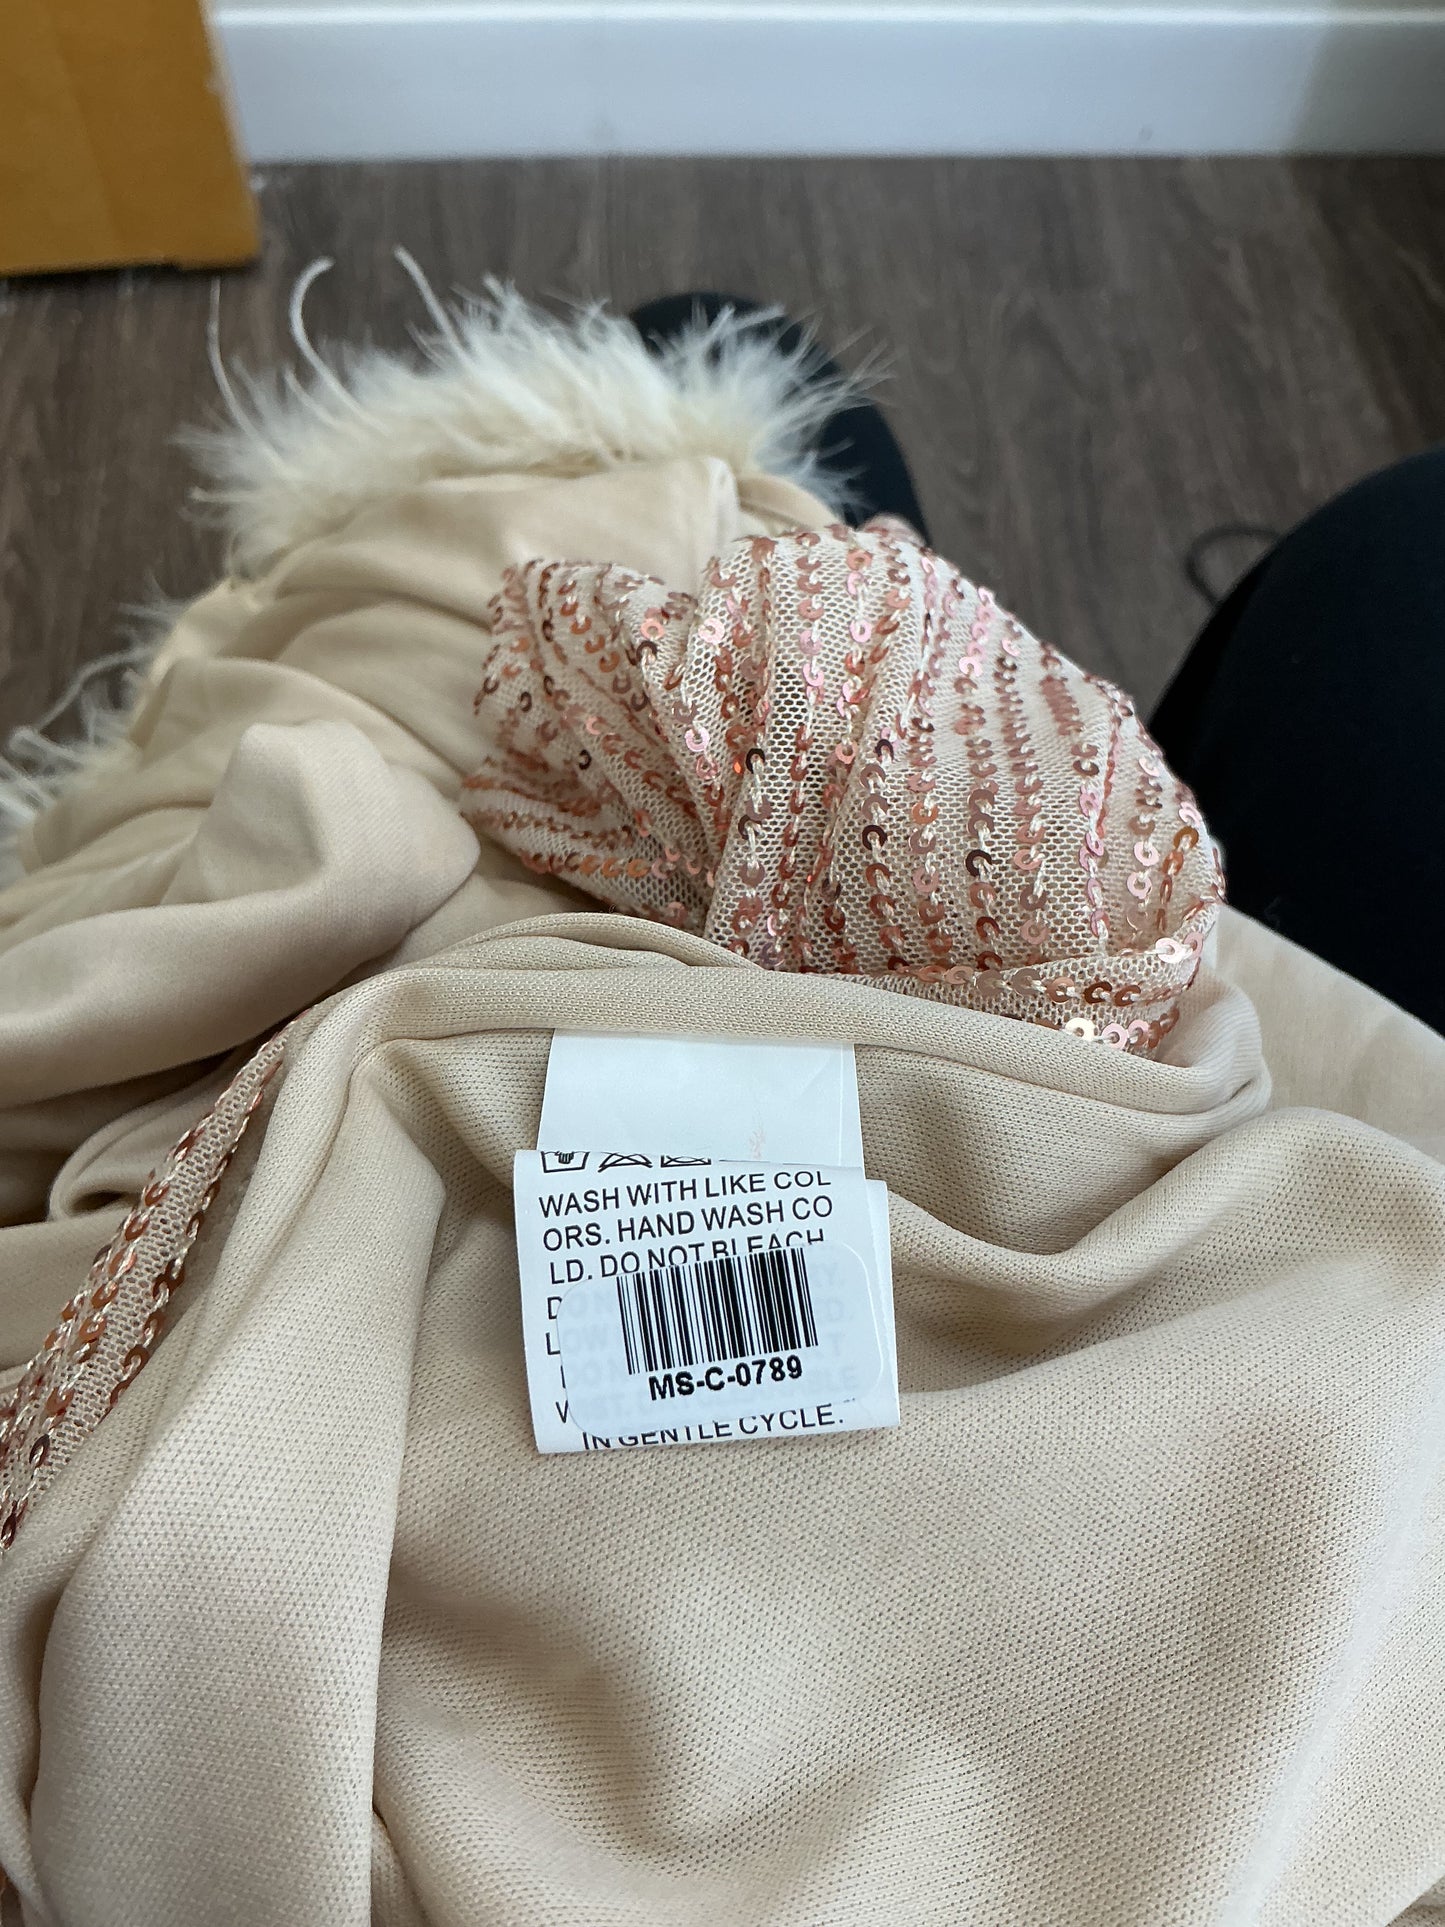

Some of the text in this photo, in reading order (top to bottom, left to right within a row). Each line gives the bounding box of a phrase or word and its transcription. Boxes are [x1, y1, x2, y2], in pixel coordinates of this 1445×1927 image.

[538, 1171, 831, 1218] WASH WITH LIKE COL
[543, 1195, 833, 1251] ORS. HAND WASH CO
[550, 1259, 592, 1285] LD.
[600, 1251, 640, 1278] DO
[647, 1242, 705, 1270] NOT
[648, 1354, 803, 1401] MS-C-0789
[738, 1403, 844, 1435] CYCLE.
